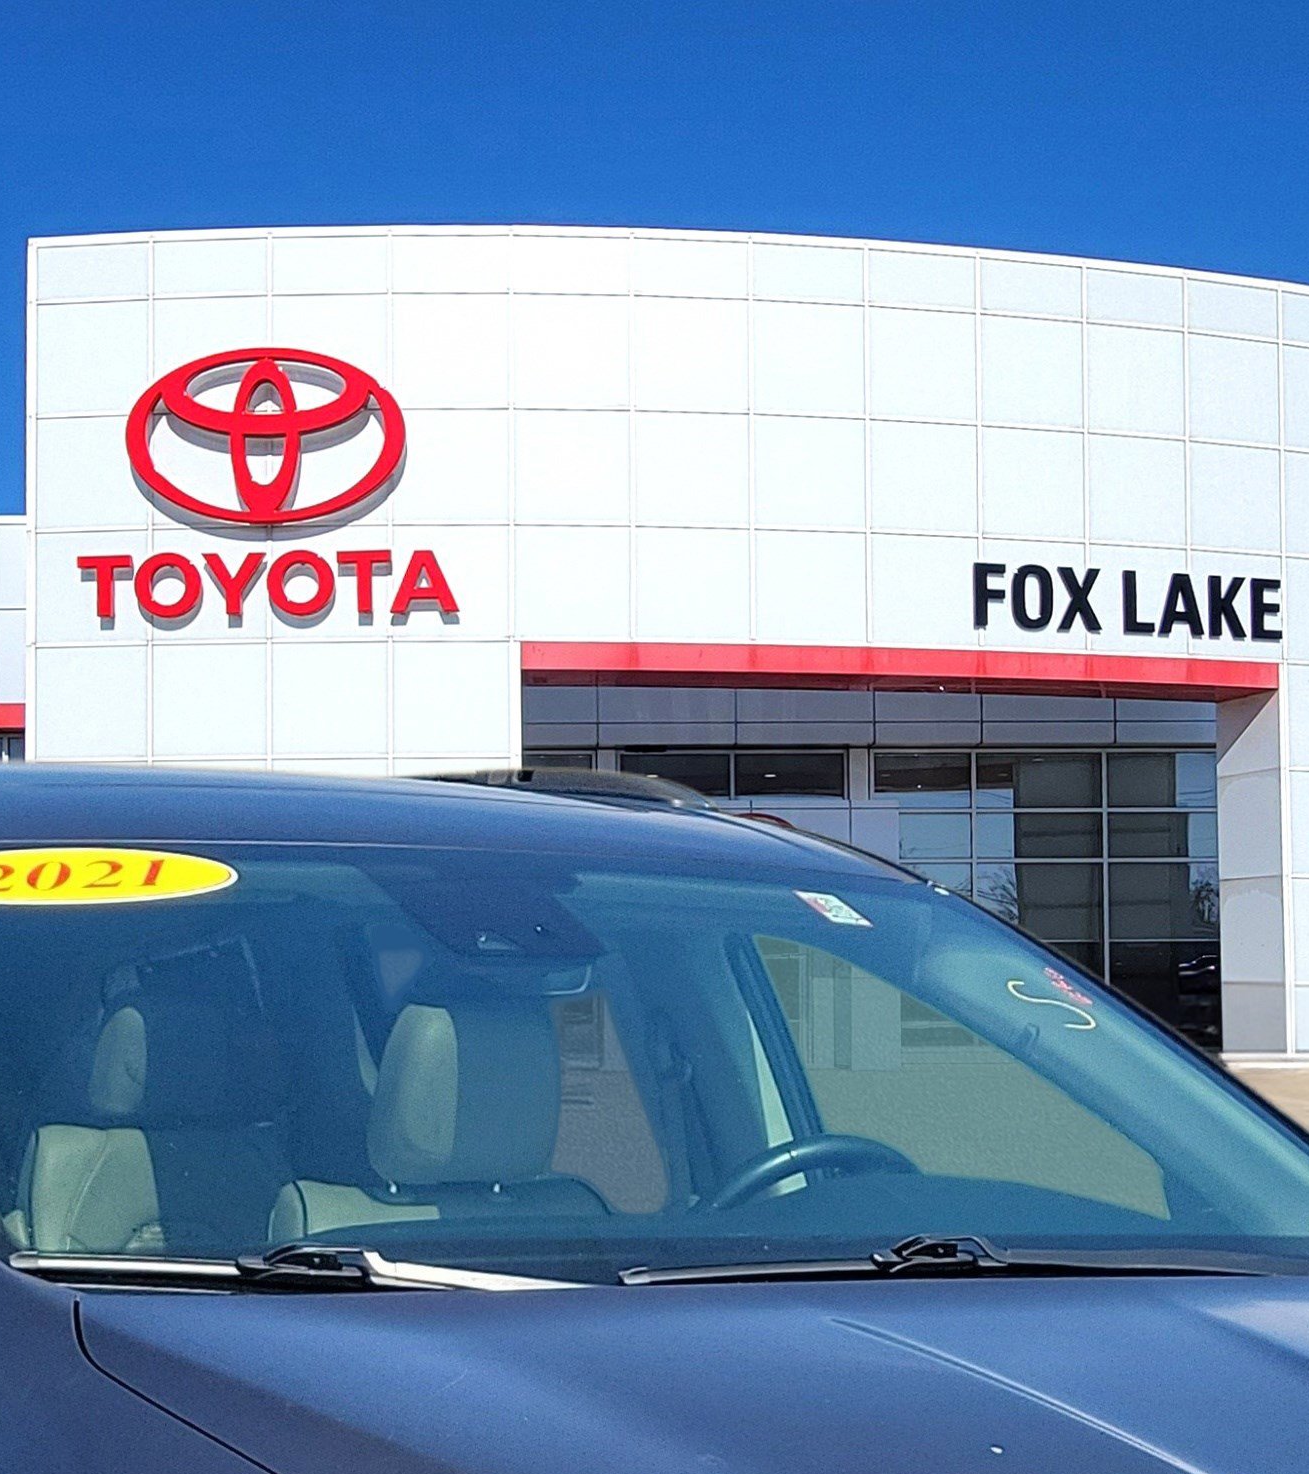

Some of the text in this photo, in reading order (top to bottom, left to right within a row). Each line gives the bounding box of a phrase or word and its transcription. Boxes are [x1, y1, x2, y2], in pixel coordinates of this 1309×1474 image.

[77, 549, 459, 622] TOYOTA
[973, 562, 1282, 640] FOX LAKE
